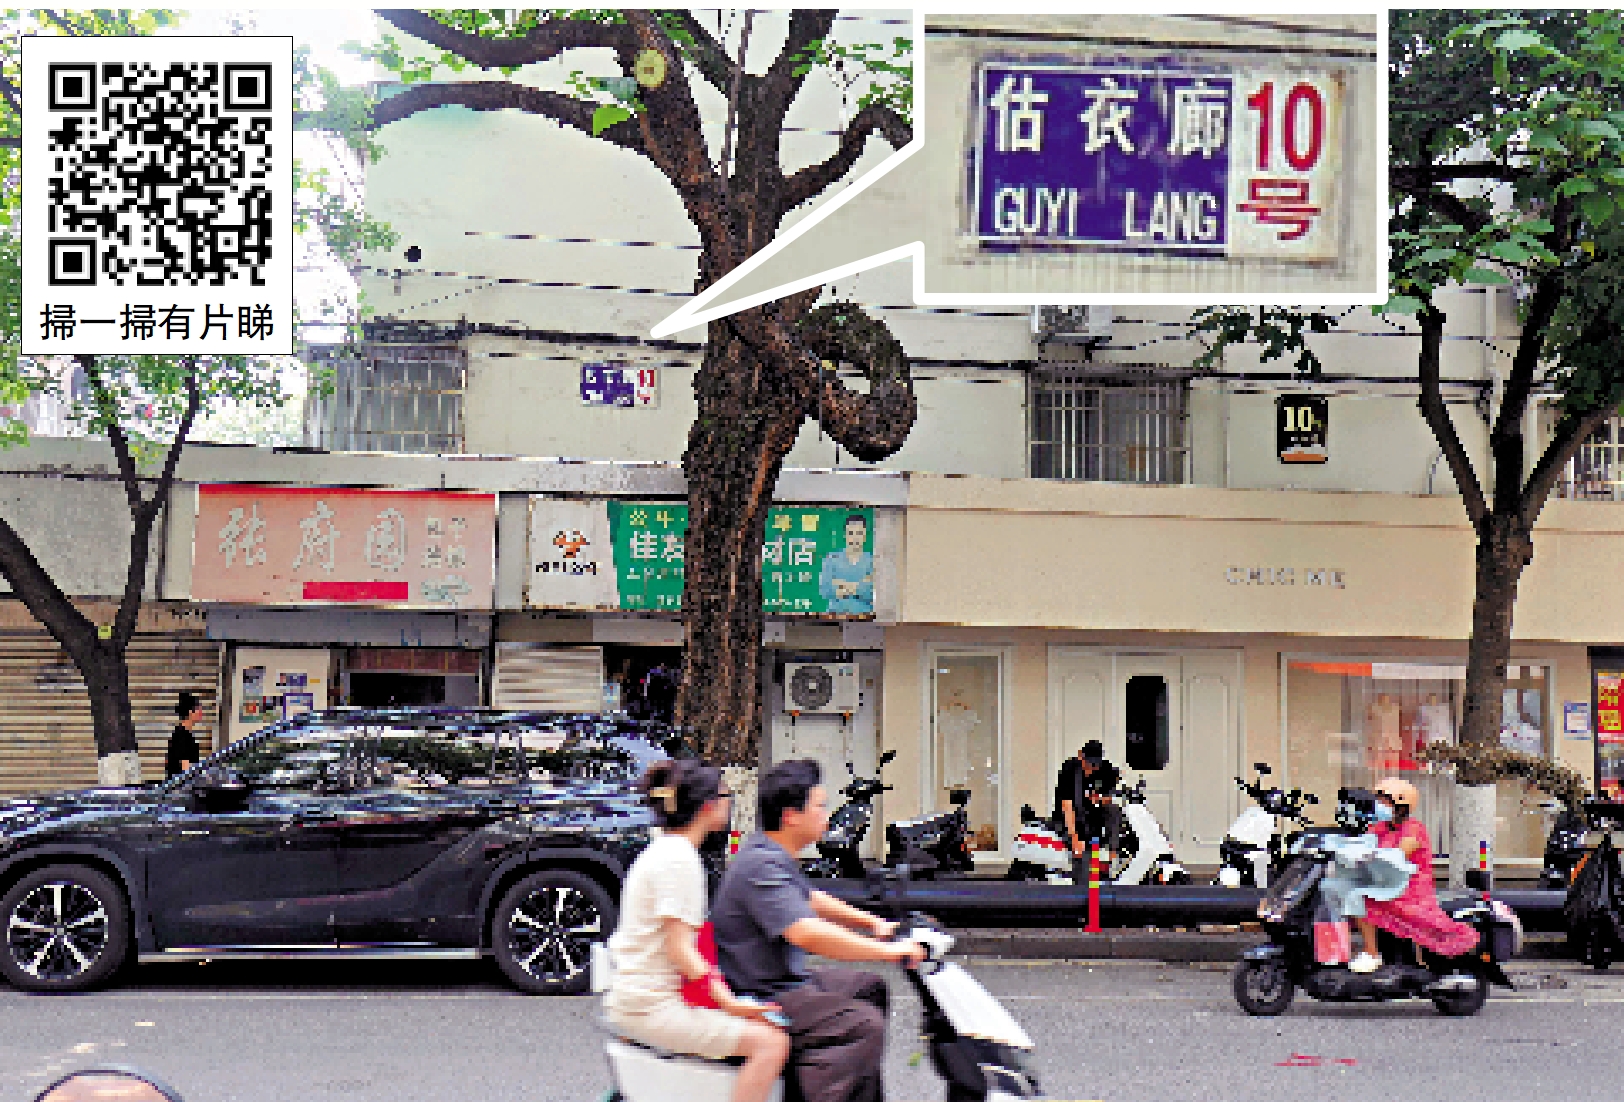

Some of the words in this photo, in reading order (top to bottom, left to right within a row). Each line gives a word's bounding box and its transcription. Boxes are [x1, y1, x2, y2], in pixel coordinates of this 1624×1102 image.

[989, 77, 1230, 158] 估衣廊
[1247, 81, 1327, 172] 10
[994, 186, 1079, 237] GUYI
[1125, 191, 1219, 241] LANG
[1236, 178, 1319, 241] 号
